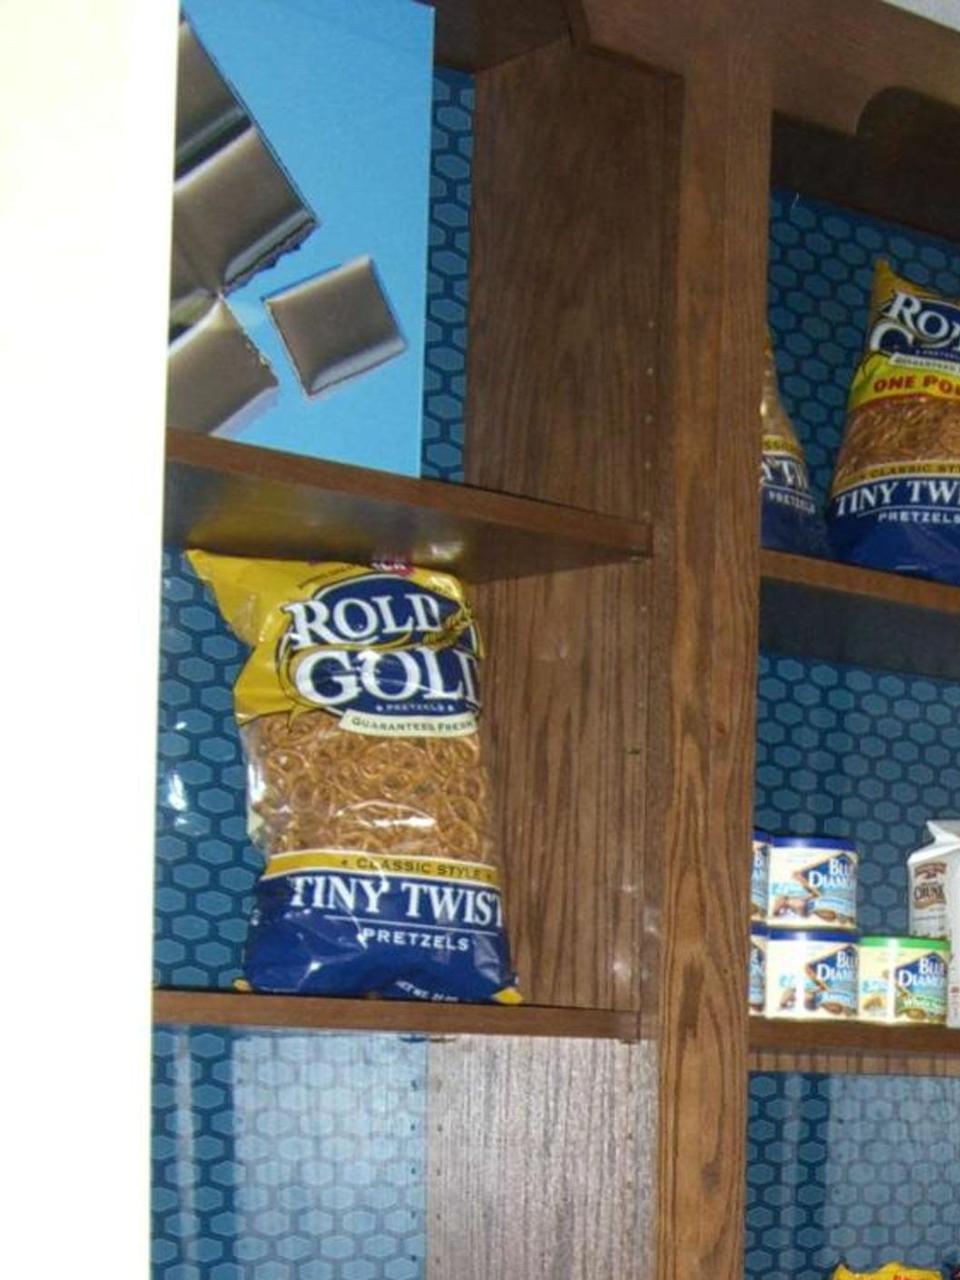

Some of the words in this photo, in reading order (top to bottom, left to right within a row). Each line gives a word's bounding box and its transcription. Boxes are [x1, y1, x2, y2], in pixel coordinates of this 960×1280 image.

[873, 375, 916, 393] ONE
[835, 481, 899, 517] TINY
[283, 593, 442, 650] ROLD
[356, 857, 433, 875] CLASSIC
[436, 864, 481, 881] STYLE
[829, 857, 851, 876] BLU
[808, 871, 852, 888] DIAM
[286, 875, 391, 914] TINY
[913, 884, 946, 901] CHUNK
[360, 927, 470, 952] PRETZELS
[836, 952, 853, 969] BLU
[816, 963, 853, 981] DIAM
[899, 971, 942, 988] DIAM
